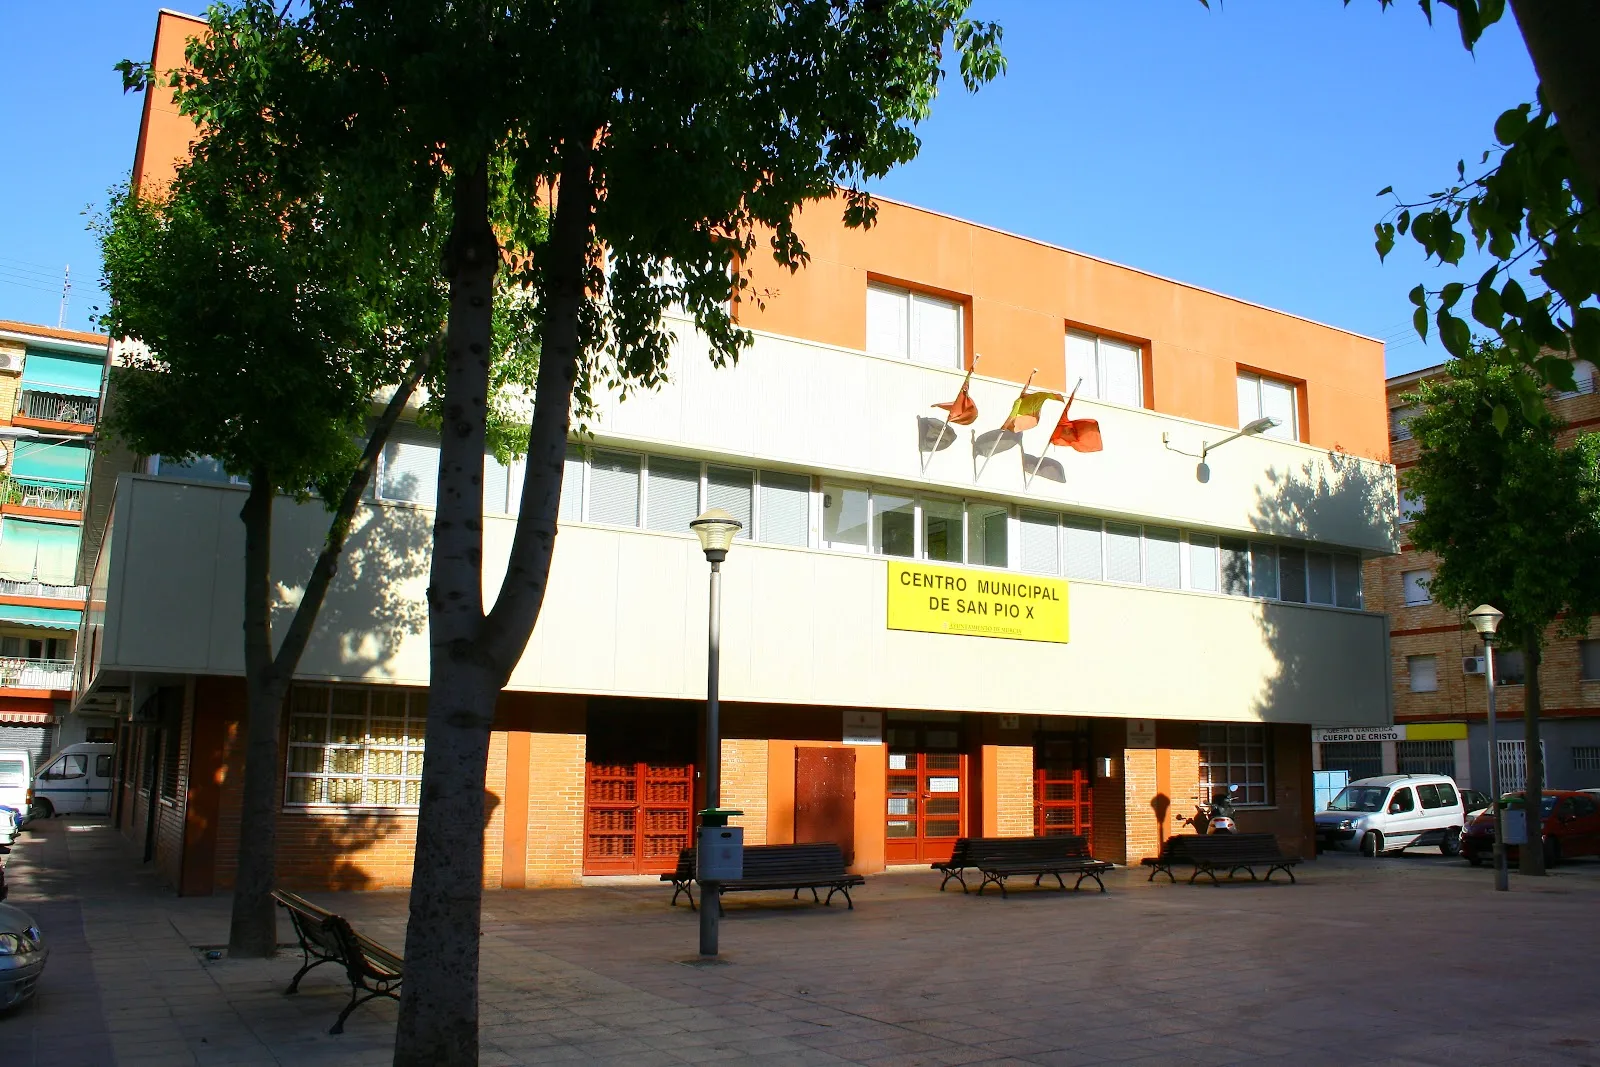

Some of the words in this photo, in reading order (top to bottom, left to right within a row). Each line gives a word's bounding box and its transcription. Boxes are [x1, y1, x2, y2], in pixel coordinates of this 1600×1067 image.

[900, 571, 967, 592] CENTRO
[977, 579, 1060, 602] MUNICIPAL
[929, 596, 950, 612] DE
[956, 599, 988, 616] SAN
[994, 603, 1020, 618] PIO
[1026, 605, 1034, 620] X
